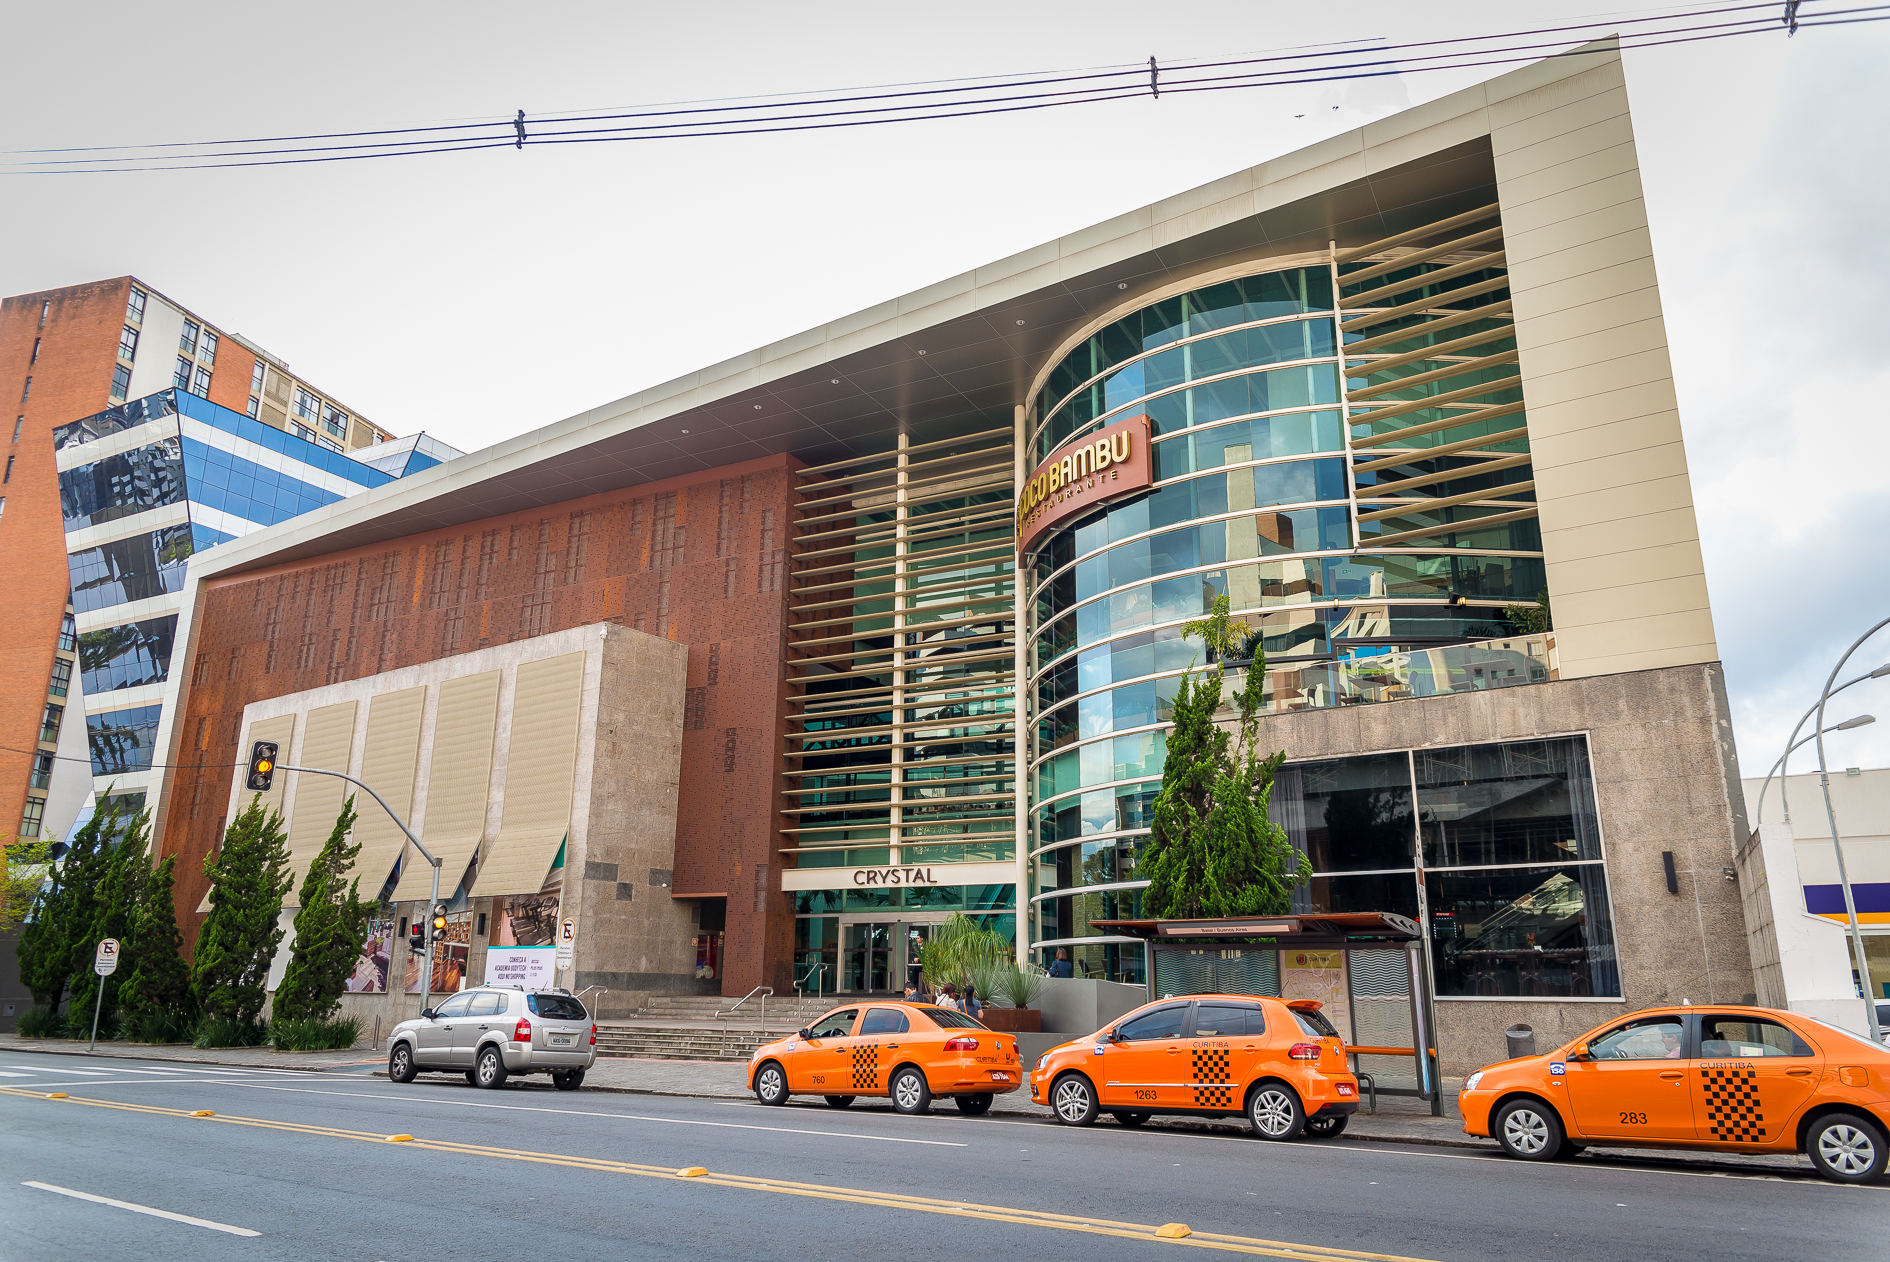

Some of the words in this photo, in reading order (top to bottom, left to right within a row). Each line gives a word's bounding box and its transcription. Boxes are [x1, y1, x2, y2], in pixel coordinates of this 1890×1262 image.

[1049, 430, 1131, 495] BAMBU
[1026, 469, 1118, 529] RESTAURANTE
[853, 867, 938, 886] CRYSTAL
[812, 1076, 826, 1084] 760
[1134, 1090, 1158, 1100] 1263
[1619, 1112, 1648, 1124] 283
